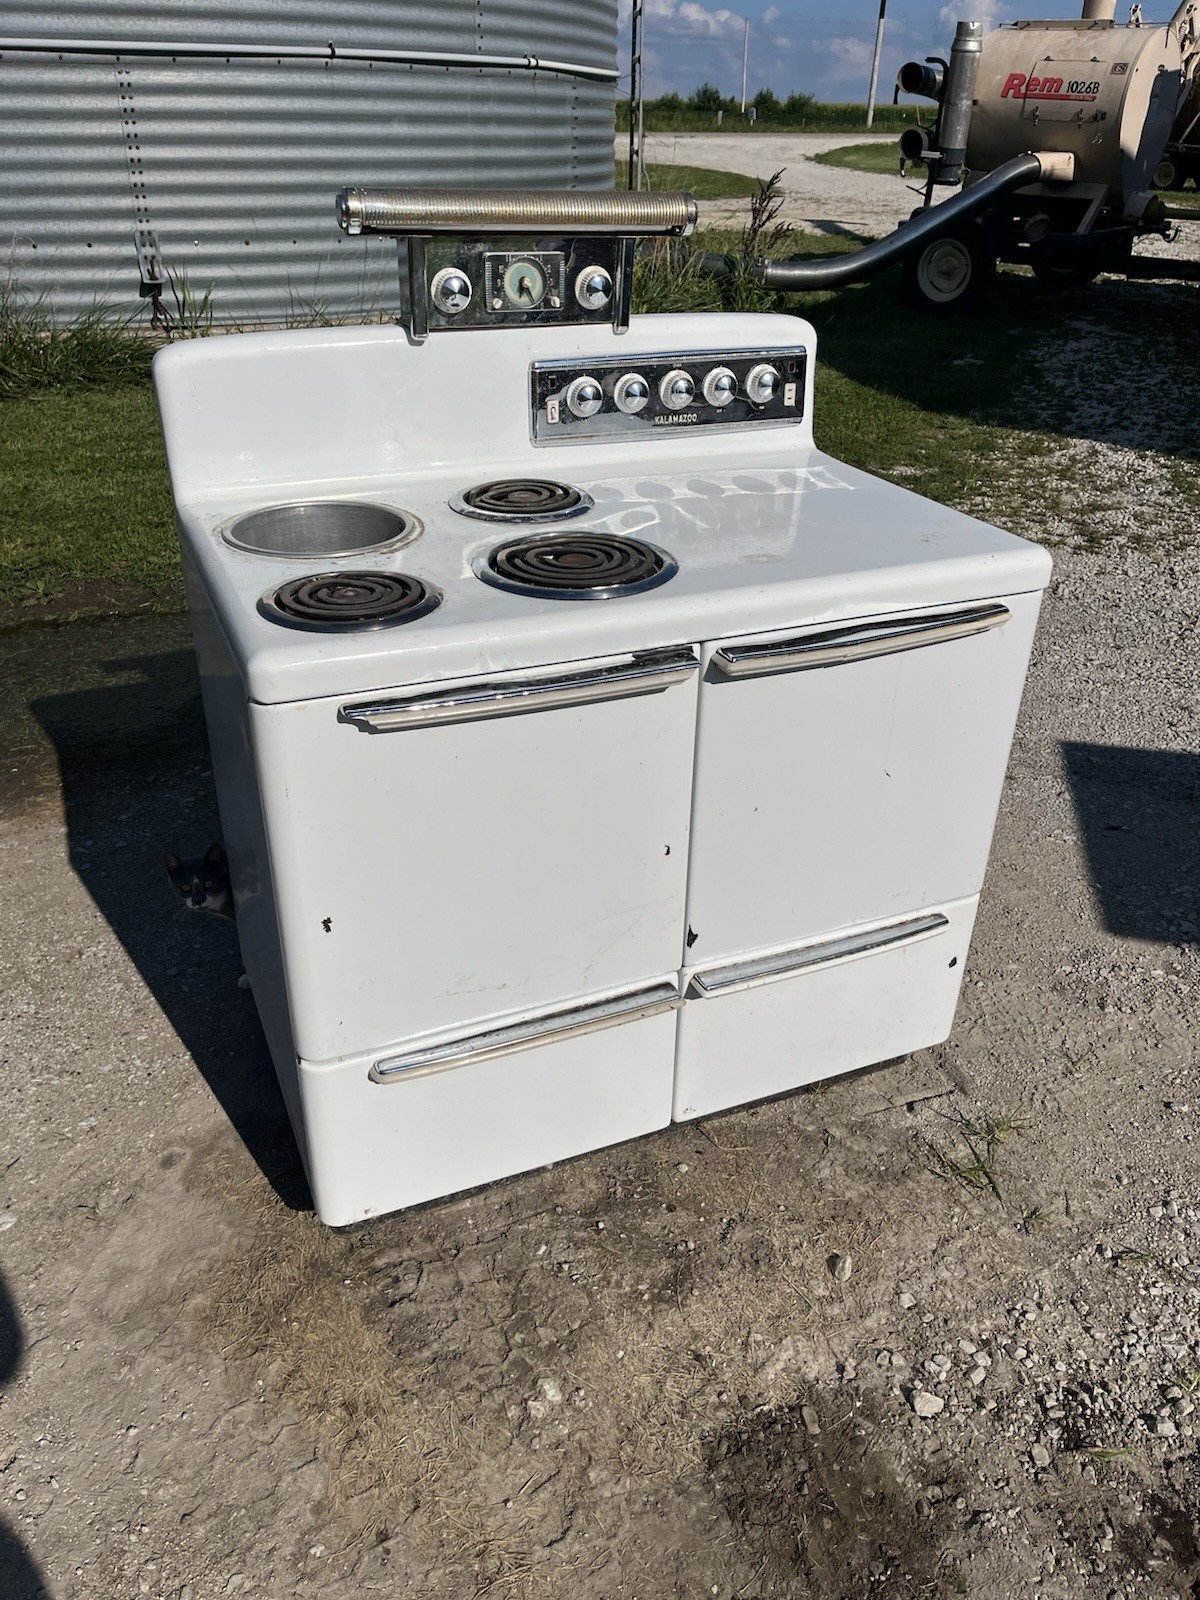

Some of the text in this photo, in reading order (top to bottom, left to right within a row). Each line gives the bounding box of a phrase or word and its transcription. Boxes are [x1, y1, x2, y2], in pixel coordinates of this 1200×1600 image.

[1000, 73, 1100, 98] Rem 1026B
[654, 413, 698, 424] KALAMAZOO
